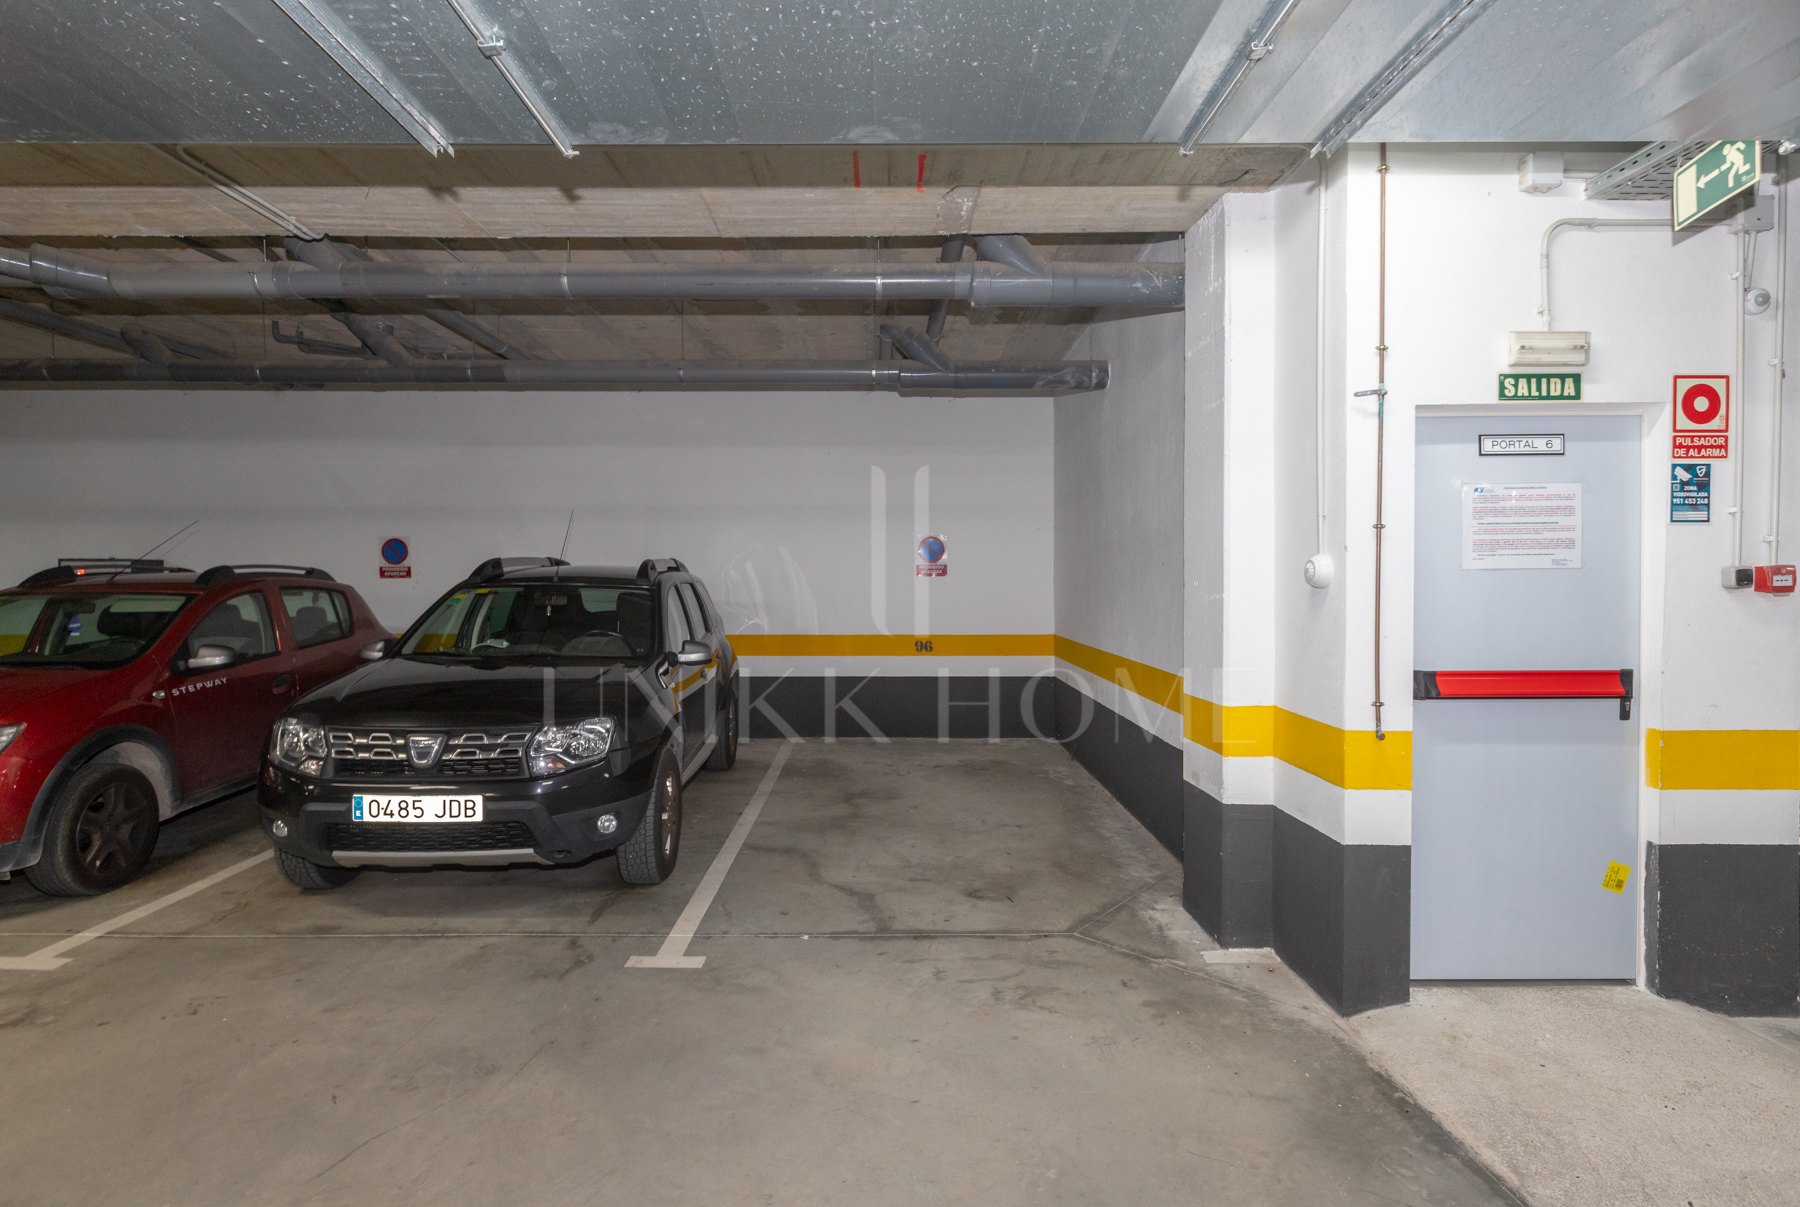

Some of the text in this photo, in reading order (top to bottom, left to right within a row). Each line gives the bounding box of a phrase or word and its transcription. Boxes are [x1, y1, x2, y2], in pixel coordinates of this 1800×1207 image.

[1503, 378, 1576, 397] SALIDA
[1491, 439, 1554, 449] PORTAL 6
[1675, 437, 1726, 446] PULSADOR
[1673, 448, 1727, 457] DE ALARMA
[1672, 497, 1684, 505] 951
[1684, 497, 1696, 505] 453
[914, 639, 933, 653] 96
[171, 676, 228, 696] STEPWAY
[368, 799, 477, 819] 0485 JDB
